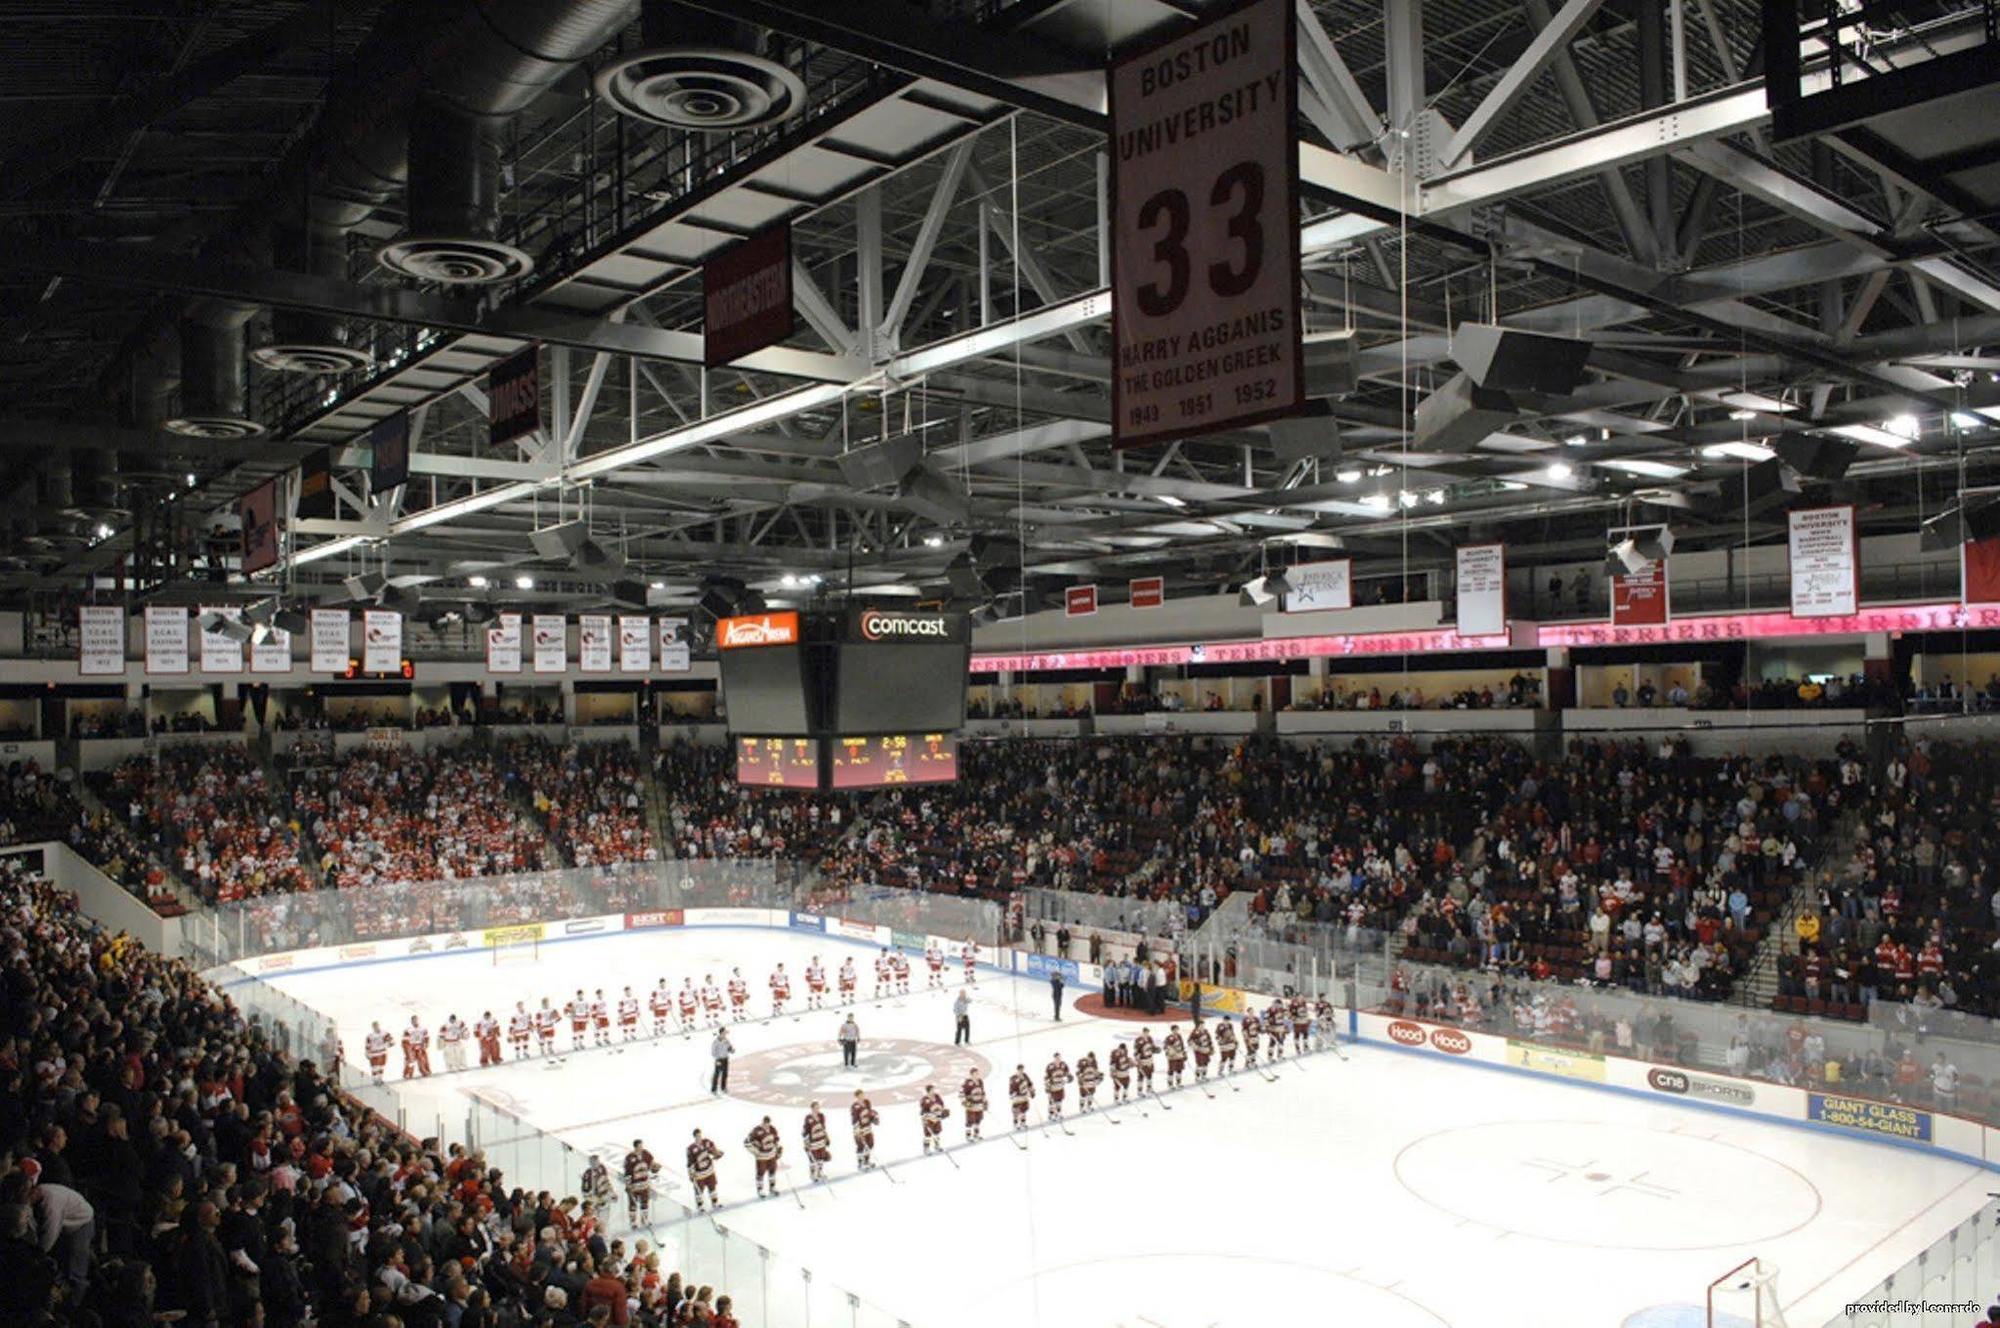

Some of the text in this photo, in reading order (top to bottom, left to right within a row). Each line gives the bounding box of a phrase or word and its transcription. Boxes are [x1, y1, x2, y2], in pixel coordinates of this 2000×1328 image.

[1141, 23, 1250, 97] BOSTON
[1119, 71, 1281, 161] UNIVERSITY
[1137, 161, 1265, 317] 33
[1121, 308, 1284, 368] HARRY AGGANIS
[1125, 343, 1281, 396] THE GOLDEN GREEK
[1235, 377, 1277, 405] 1952
[1793, 519, 1848, 530] UNIVERSITY
[1803, 512, 1840, 521] BOSTON
[1569, 624, 1742, 644] TERRIERS
[1391, 1025, 1468, 1052] Hood Hood
[1692, 1081, 1753, 1101] SPORTS
[1823, 1097, 1916, 1124] GIANT GLASS
